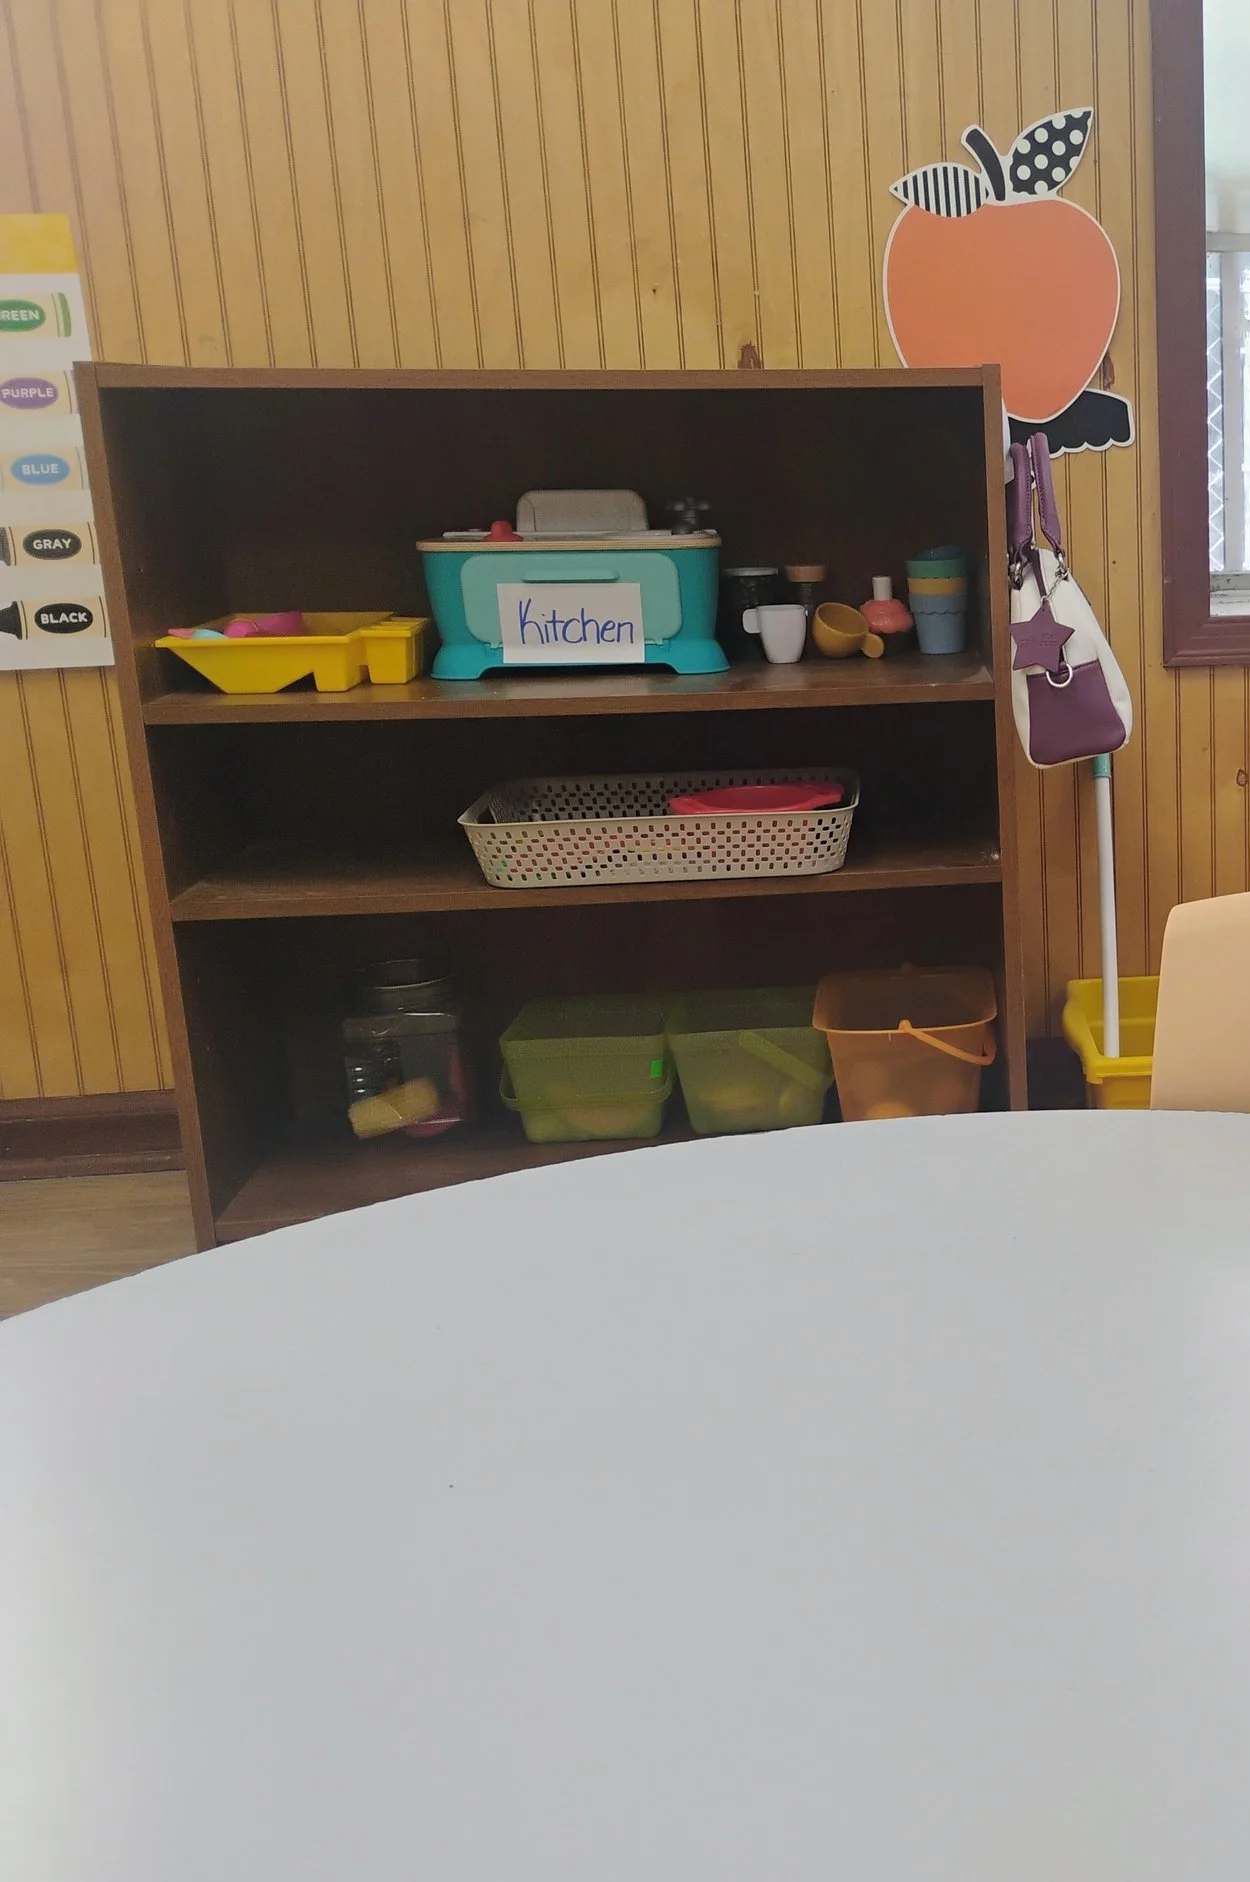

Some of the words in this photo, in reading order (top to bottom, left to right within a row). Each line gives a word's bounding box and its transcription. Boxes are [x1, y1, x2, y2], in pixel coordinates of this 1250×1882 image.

[1, 387, 55, 399] PURPLE
[21, 463, 60, 476] BLUE
[32, 538, 72, 550] GRAY
[40, 611, 88, 624] BLACK
[519, 598, 634, 644] Kitchen
